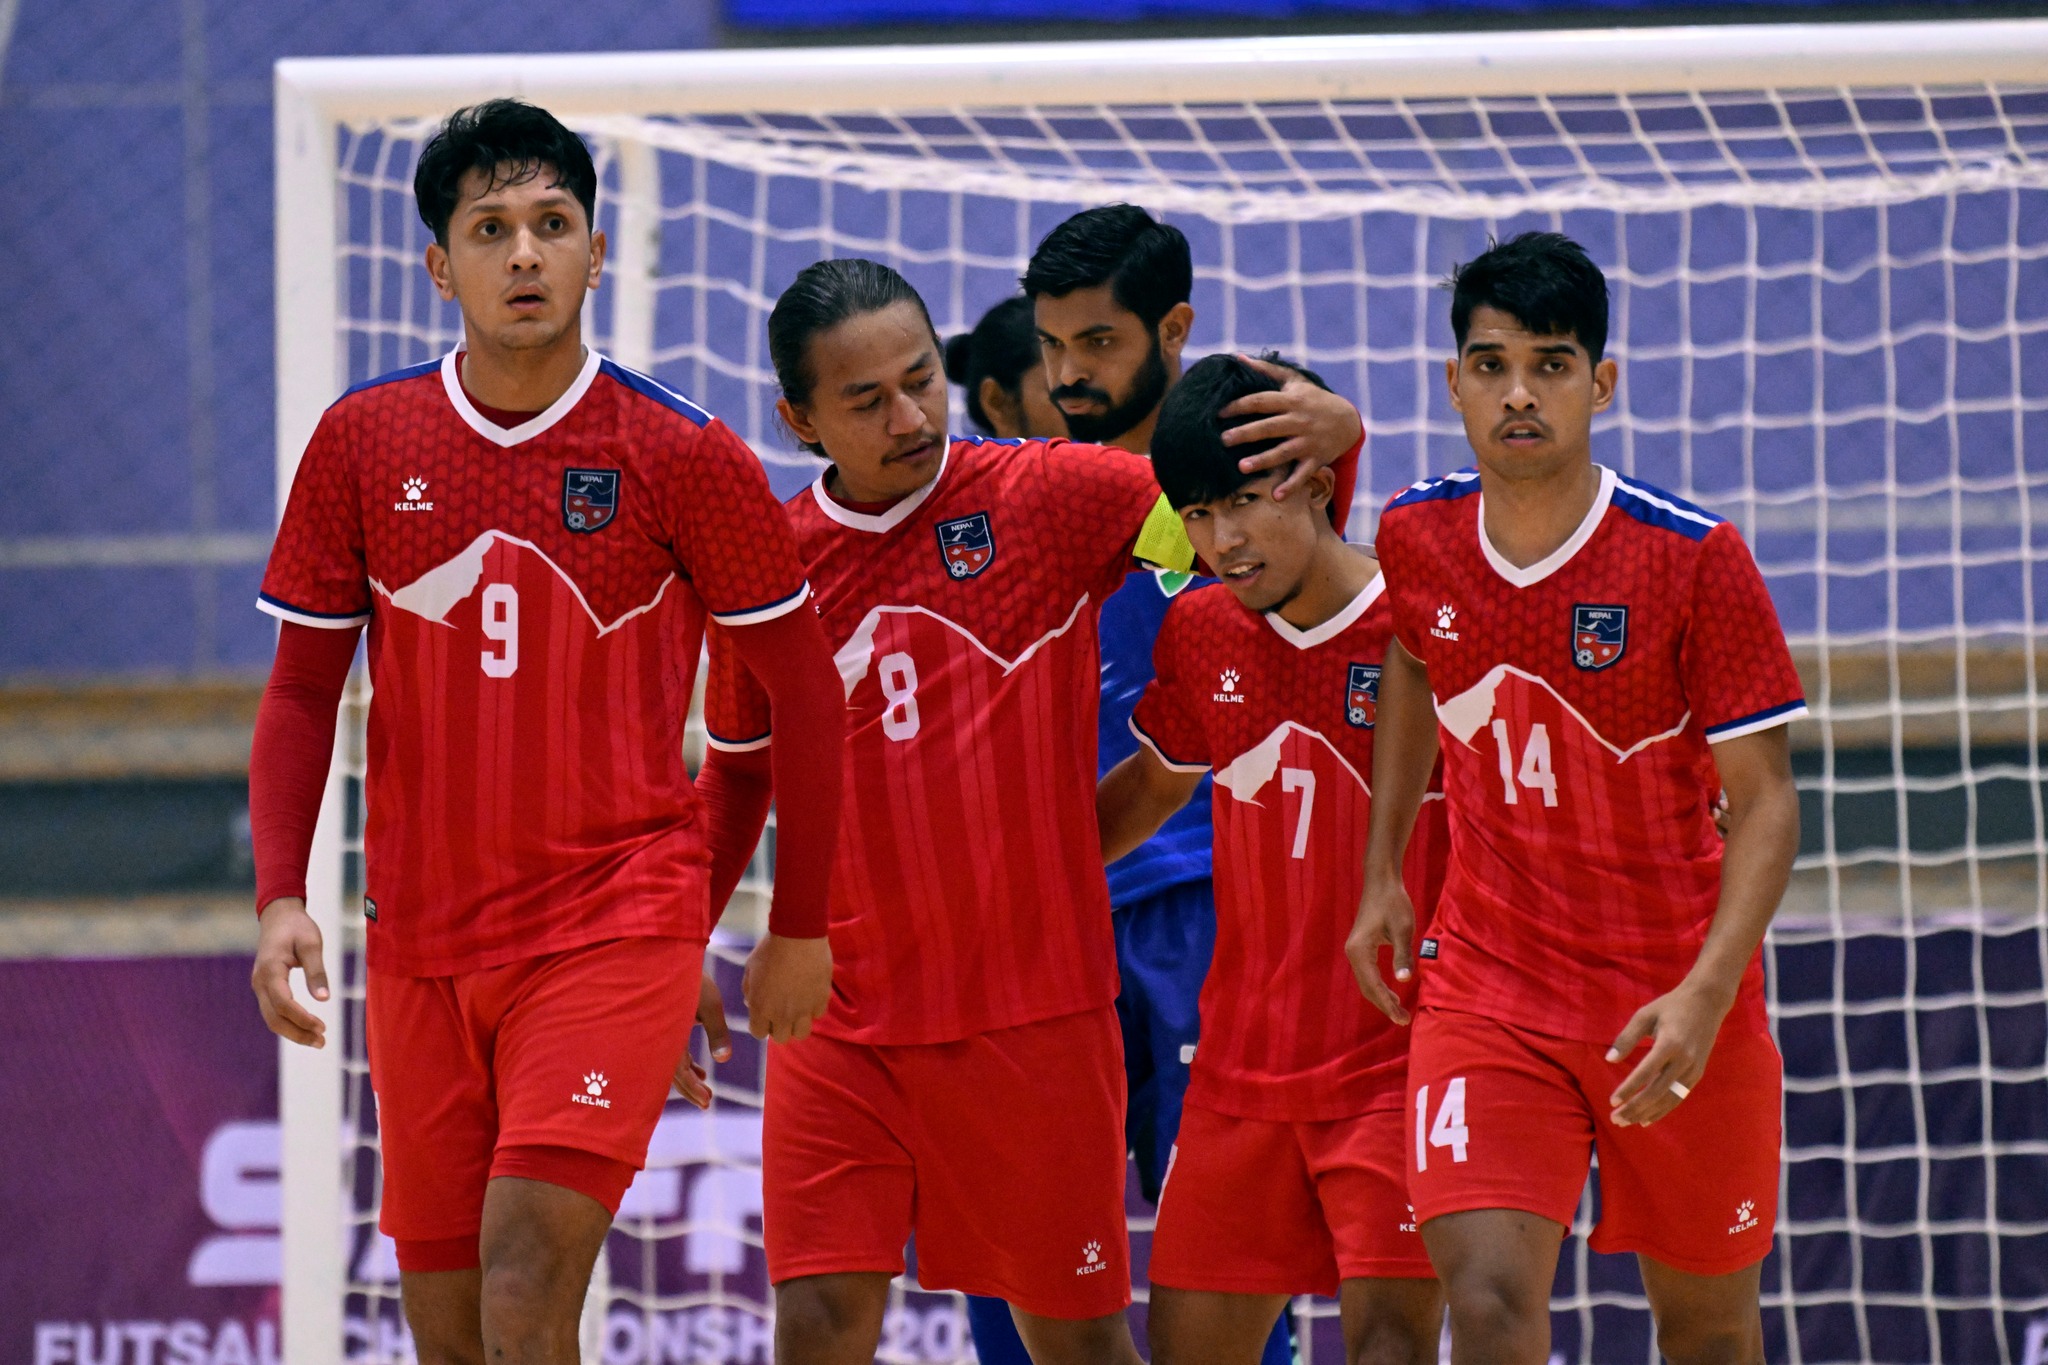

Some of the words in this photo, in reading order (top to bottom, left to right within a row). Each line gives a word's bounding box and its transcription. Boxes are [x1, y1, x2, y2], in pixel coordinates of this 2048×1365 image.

[580, 475, 603, 483] NEPAL
[394, 502, 434, 511] KELME
[950, 521, 974, 532] NEPAL
[1588, 611, 1613, 620] NEPAL
[481, 584, 519, 678] 9
[1430, 627, 1460, 642] KELME
[1363, 670, 1381, 679] NEP
[878, 651, 920, 742] 8
[1213, 693, 1245, 703] KELME
[1491, 718, 1559, 808] 14
[1281, 768, 1316, 859] 7
[571, 1093, 611, 1109] KELME
[1415, 1077, 1469, 1173] 14
[1728, 1217, 1759, 1235] KELME
[1076, 1261, 1107, 1276] KELME
